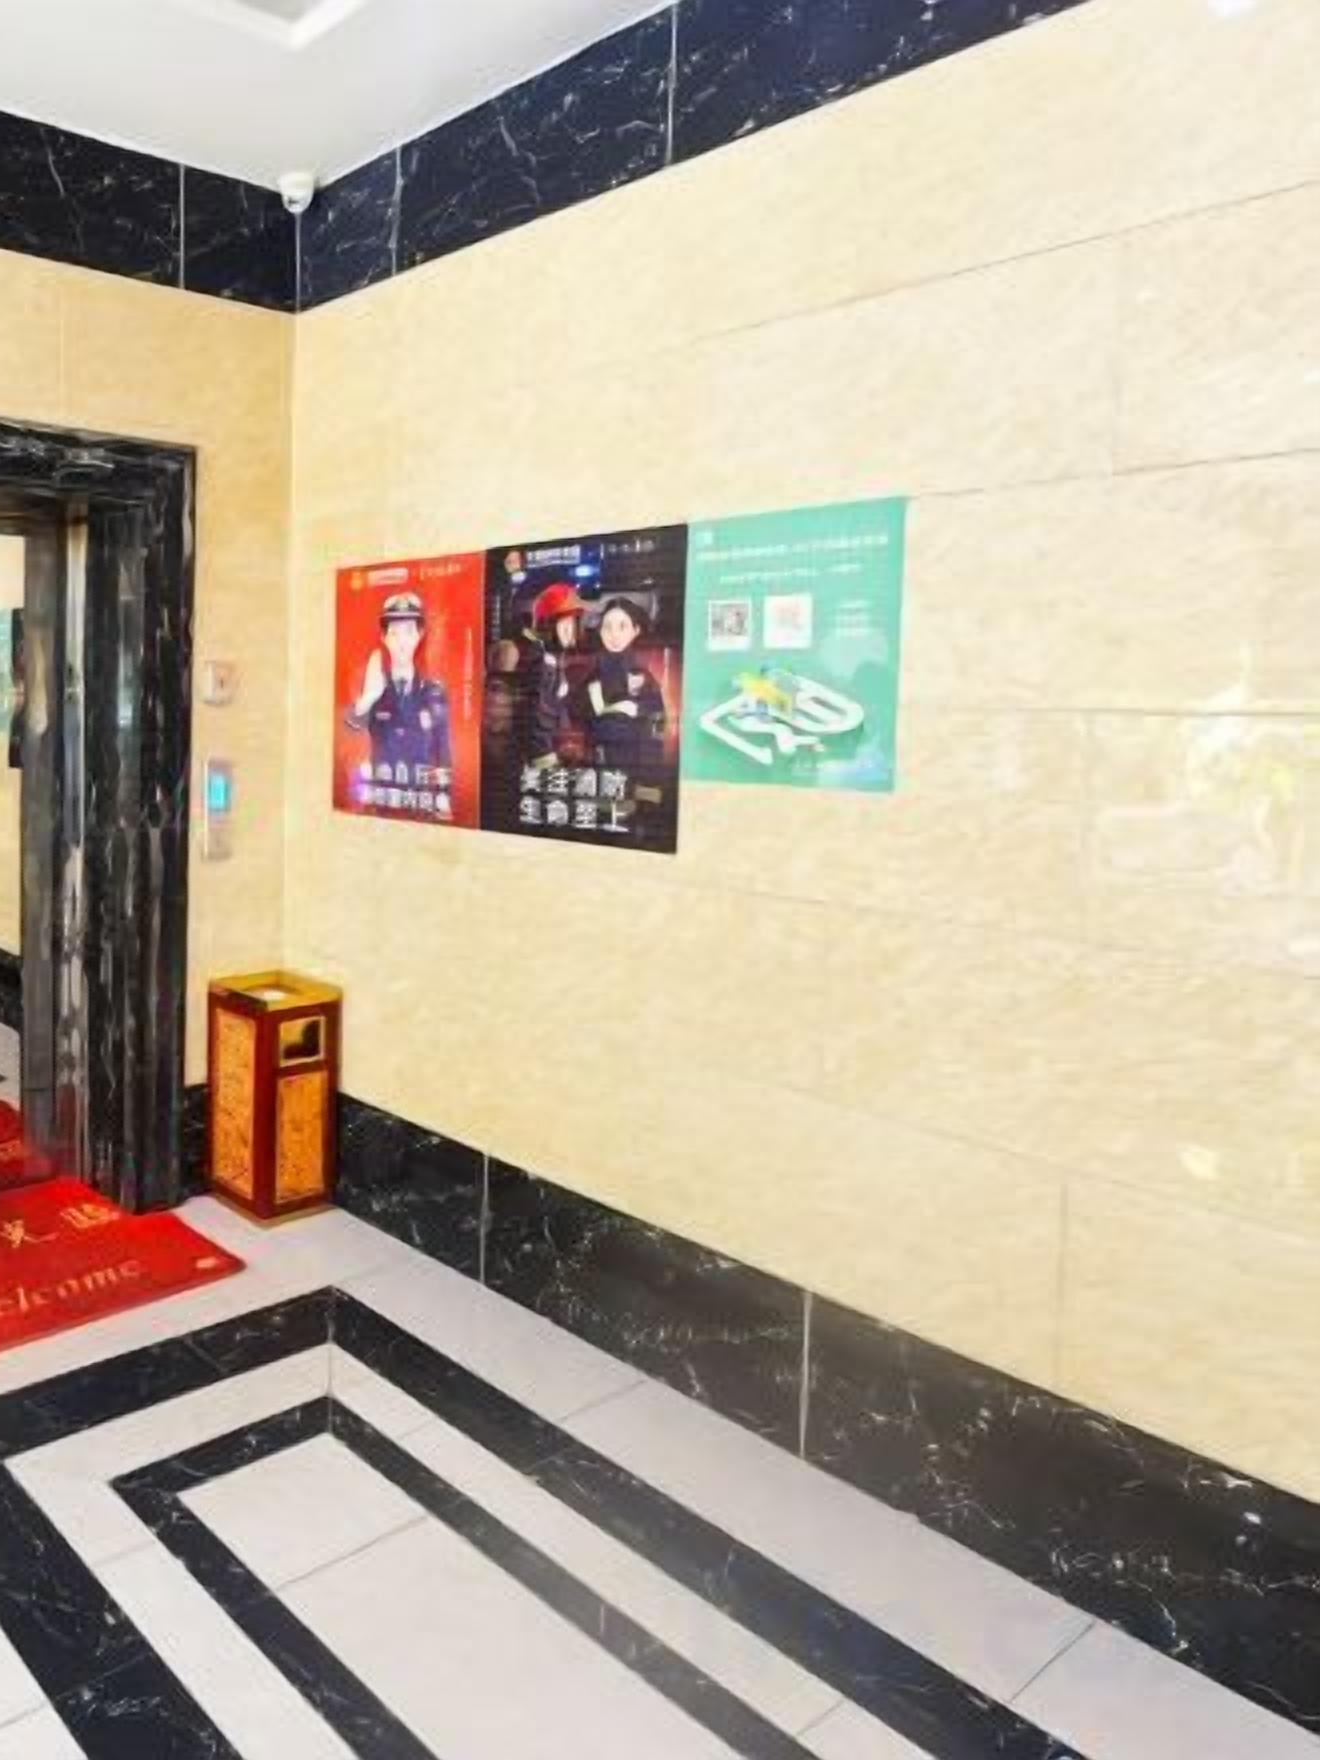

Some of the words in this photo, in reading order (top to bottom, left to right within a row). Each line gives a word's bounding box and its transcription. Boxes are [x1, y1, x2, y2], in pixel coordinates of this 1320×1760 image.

[520, 764, 628, 800] 关注消防
[519, 796, 629, 833] 生命至上
